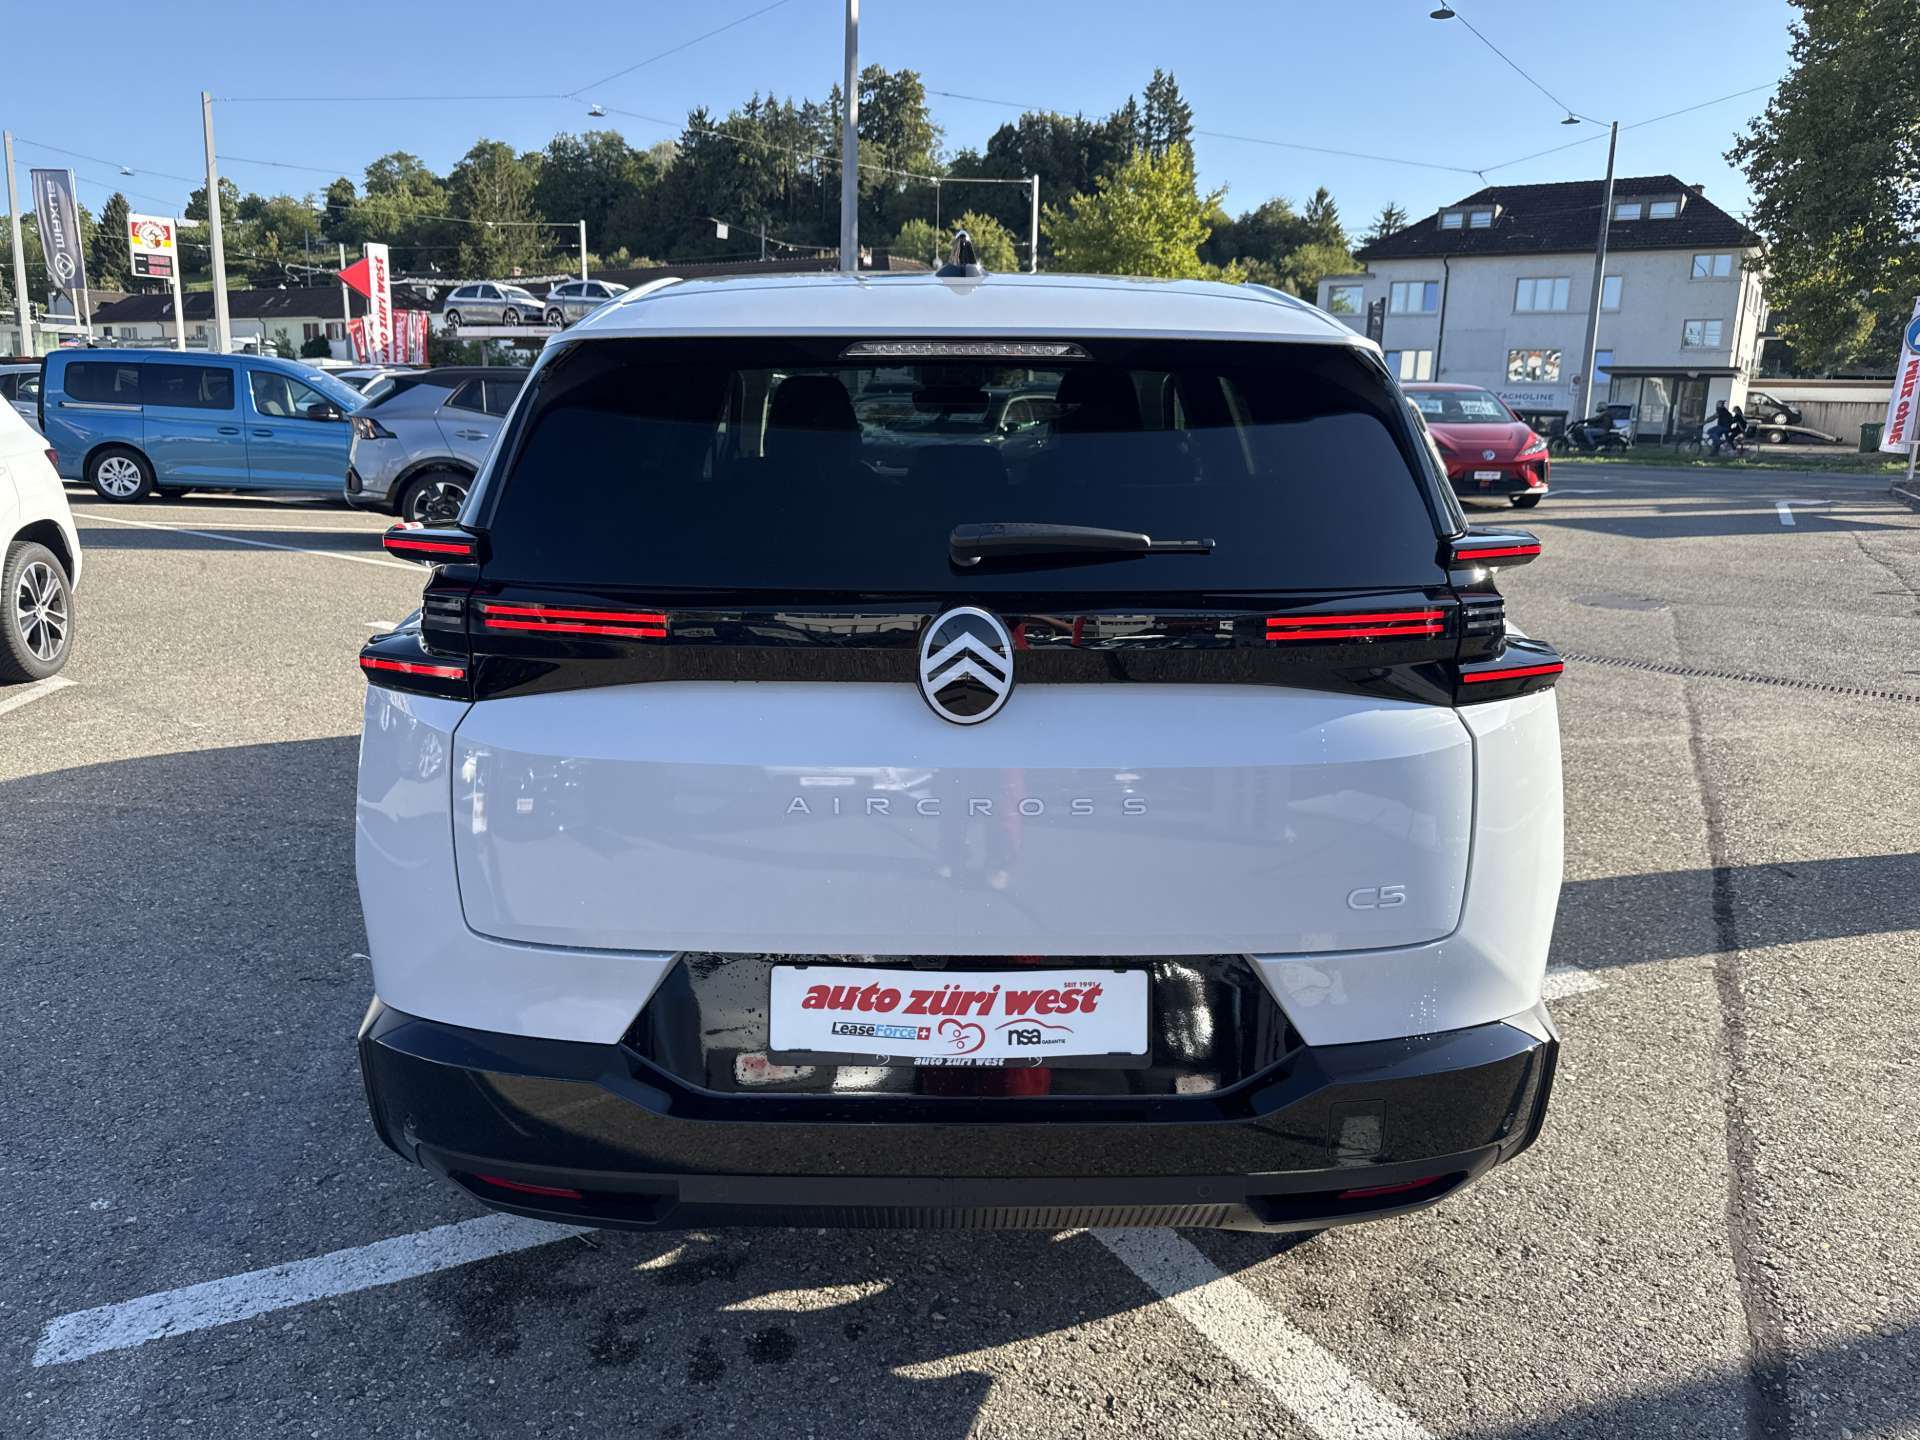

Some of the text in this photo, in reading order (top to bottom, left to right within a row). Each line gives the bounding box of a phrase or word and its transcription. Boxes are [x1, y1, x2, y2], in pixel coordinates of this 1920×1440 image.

[786, 797, 1147, 816] AIRCROSS
[1346, 884, 1406, 910] C5
[801, 981, 1103, 1016] auto züri west
[1008, 1029, 1041, 1046] nsa
[913, 1056, 943, 1066] auto
[975, 1057, 1004, 1066] west
